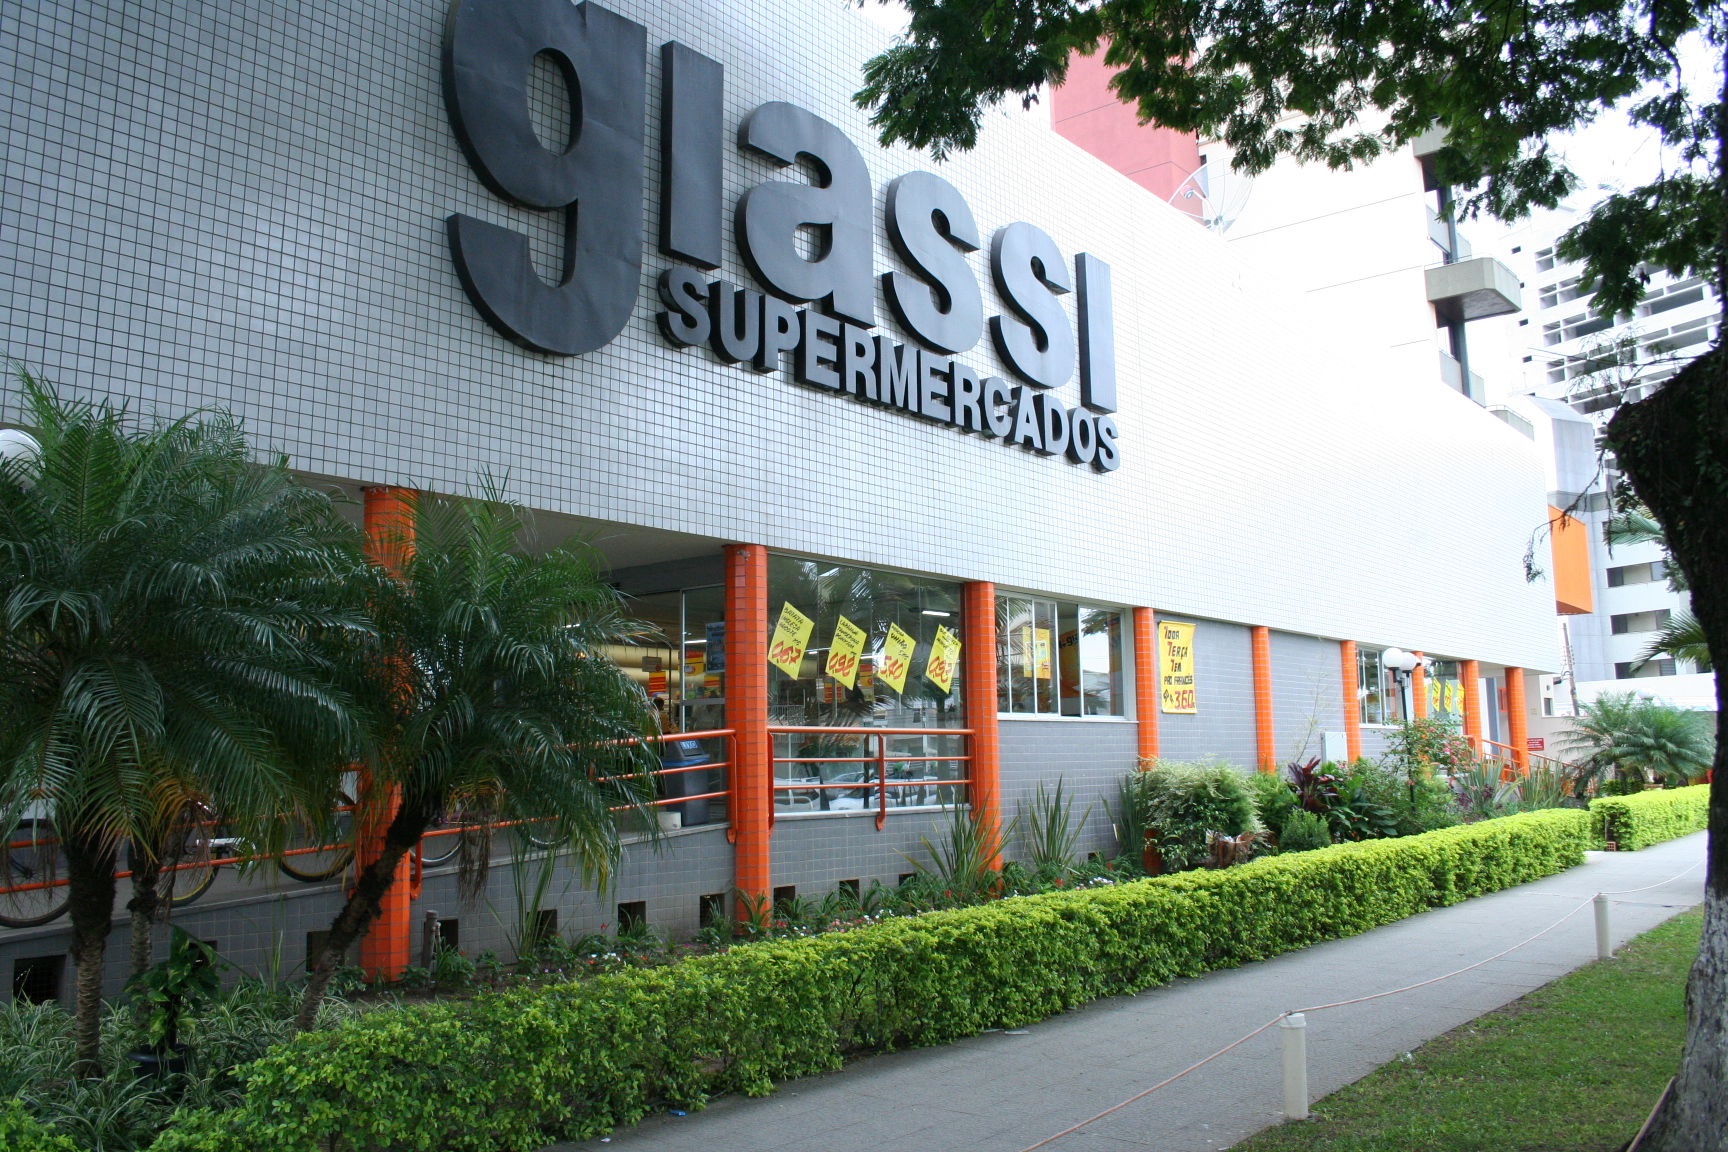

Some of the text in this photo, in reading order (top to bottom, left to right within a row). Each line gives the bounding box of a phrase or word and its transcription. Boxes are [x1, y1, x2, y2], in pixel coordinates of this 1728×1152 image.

[656, 264, 1120, 473] SUPERMERCADOS
[784, 606, 804, 625] BATATA
[1164, 626, 1179, 640] TODA
[1167, 641, 1188, 660] TERÇA
[1170, 659, 1182, 672] TEM
[680, 741, 698, 749] LIXO
